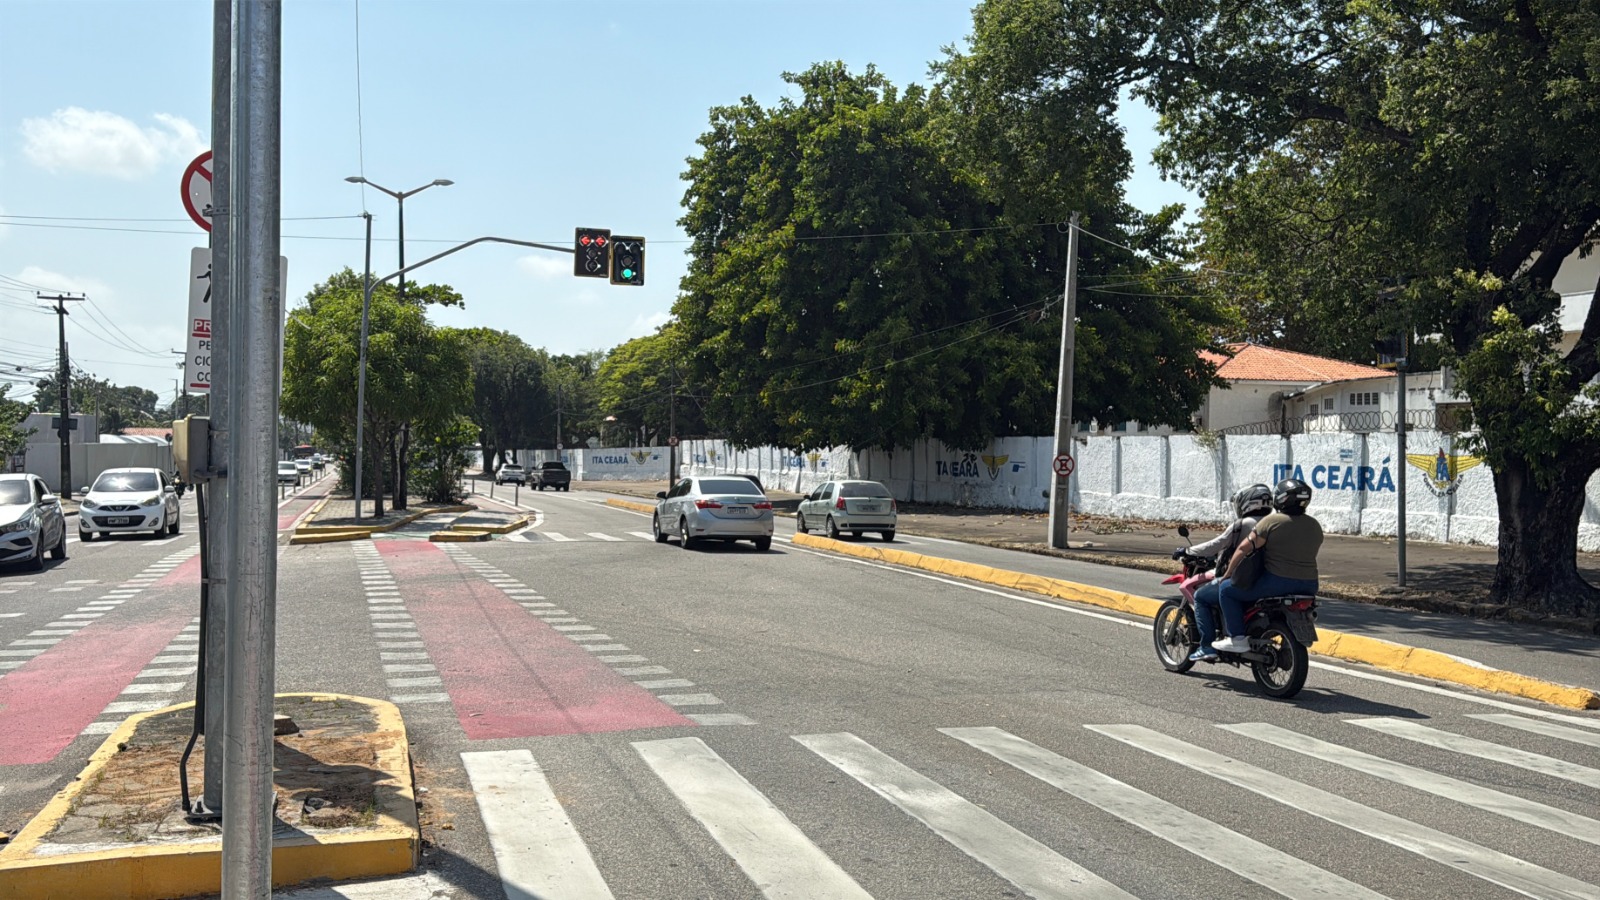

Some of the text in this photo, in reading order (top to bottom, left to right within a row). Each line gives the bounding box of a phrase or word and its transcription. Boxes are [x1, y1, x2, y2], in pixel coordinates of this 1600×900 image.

[592, 456, 603, 464] ITA
[1273, 456, 1396, 492] ITA CEARÁ
